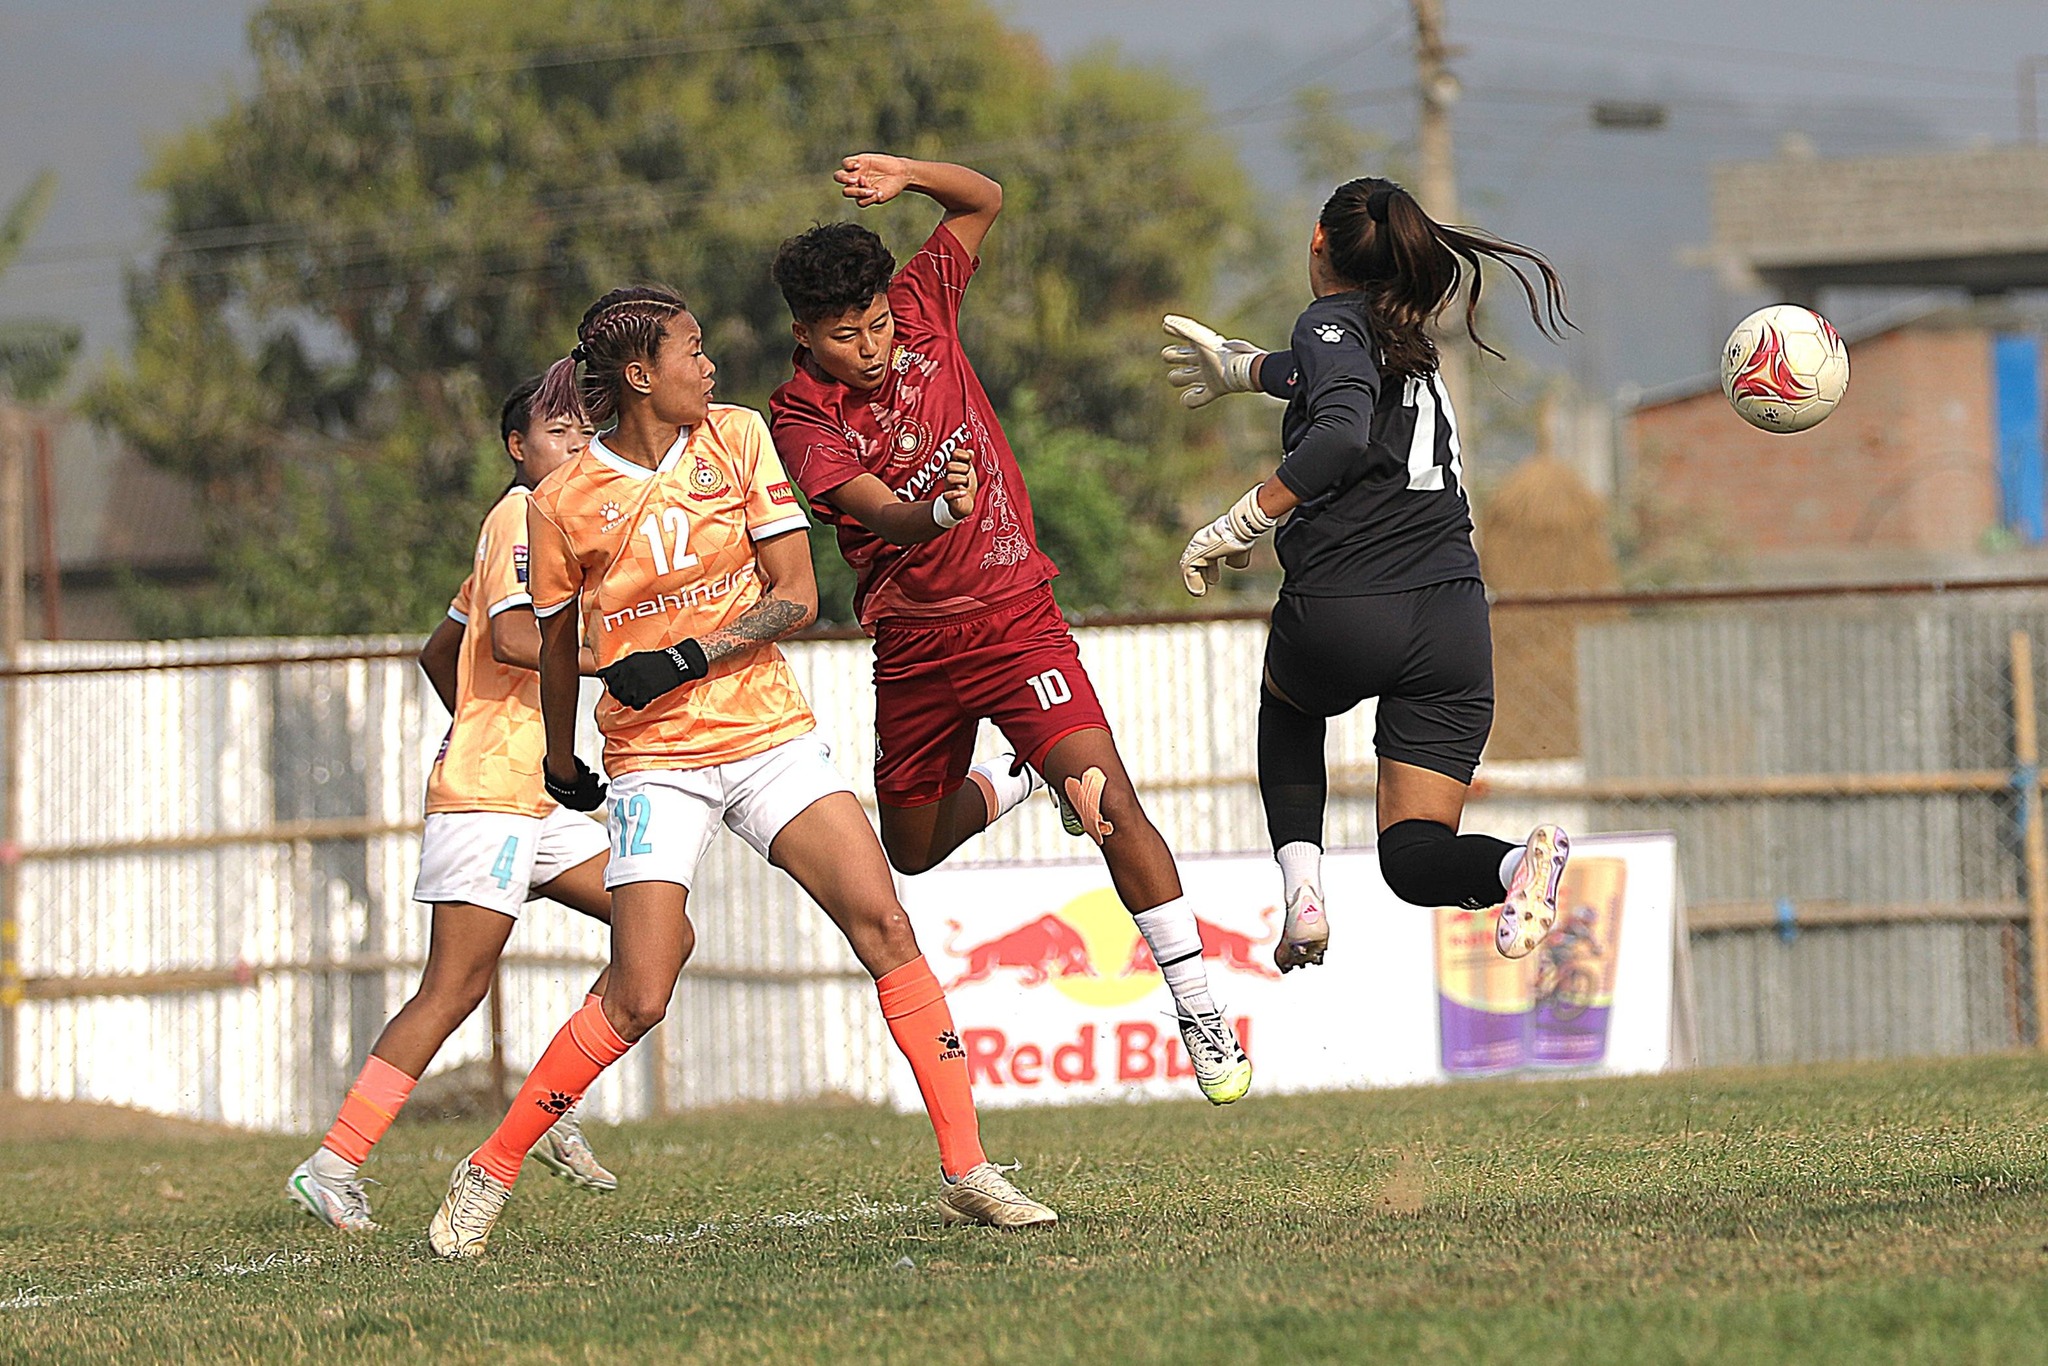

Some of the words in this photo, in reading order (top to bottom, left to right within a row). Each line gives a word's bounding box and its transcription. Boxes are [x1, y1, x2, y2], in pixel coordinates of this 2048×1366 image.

[637, 505, 700, 577] 12
[602, 557, 756, 632] mahindra
[665, 647, 689, 671] SPORT
[1026, 668, 1072, 711] 10
[614, 793, 652, 859] 12
[489, 834, 520, 891] 4
[962, 1024, 1096, 1085] Red
